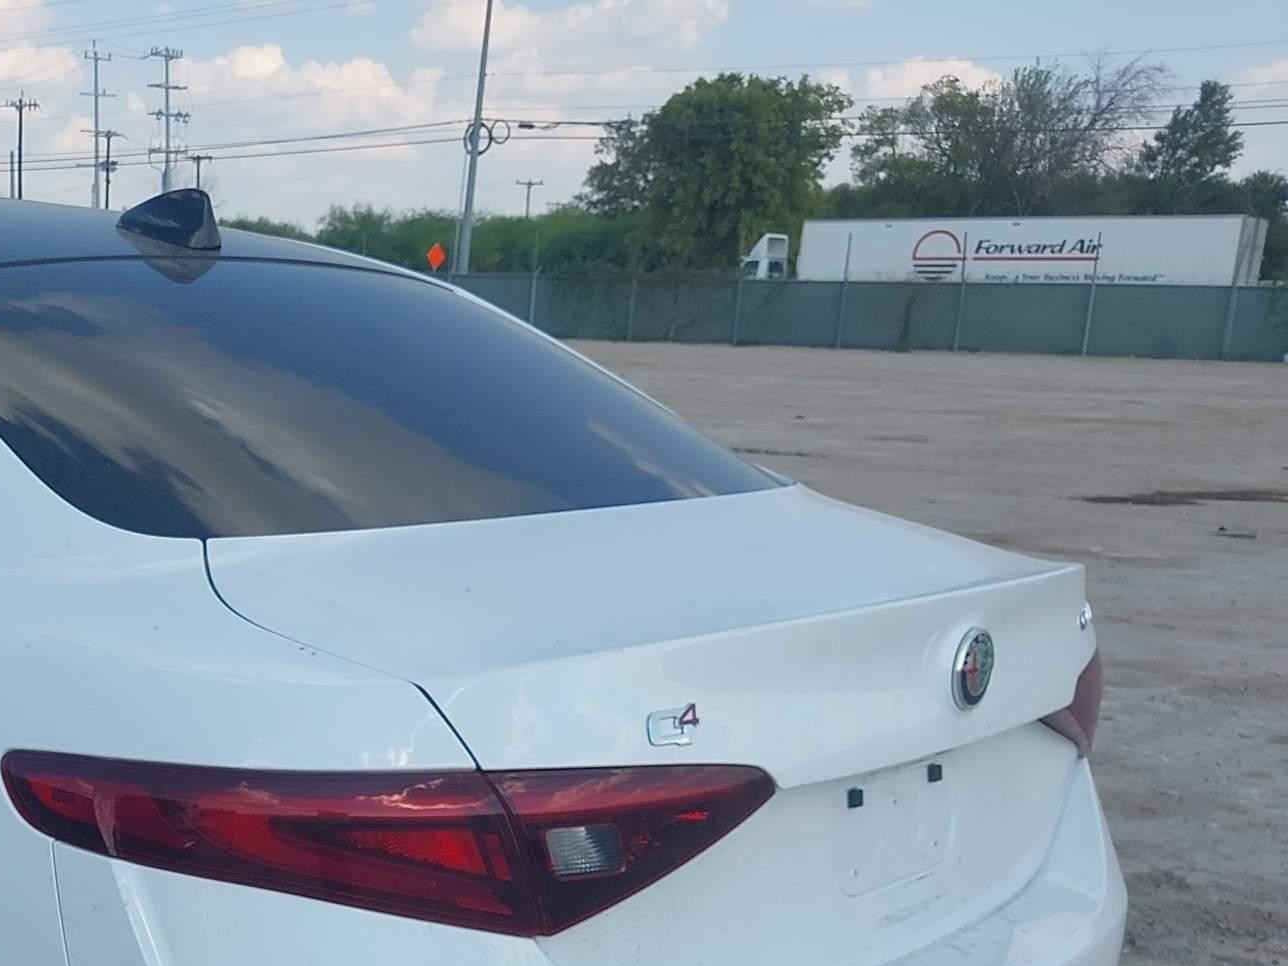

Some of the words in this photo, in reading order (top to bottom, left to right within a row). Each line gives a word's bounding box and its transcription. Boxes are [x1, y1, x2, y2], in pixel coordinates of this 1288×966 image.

[974, 239, 1067, 255] Forward
[1068, 238, 1103, 255] Air
[1043, 273, 1080, 282] Business
[1083, 273, 1116, 283] Mving
